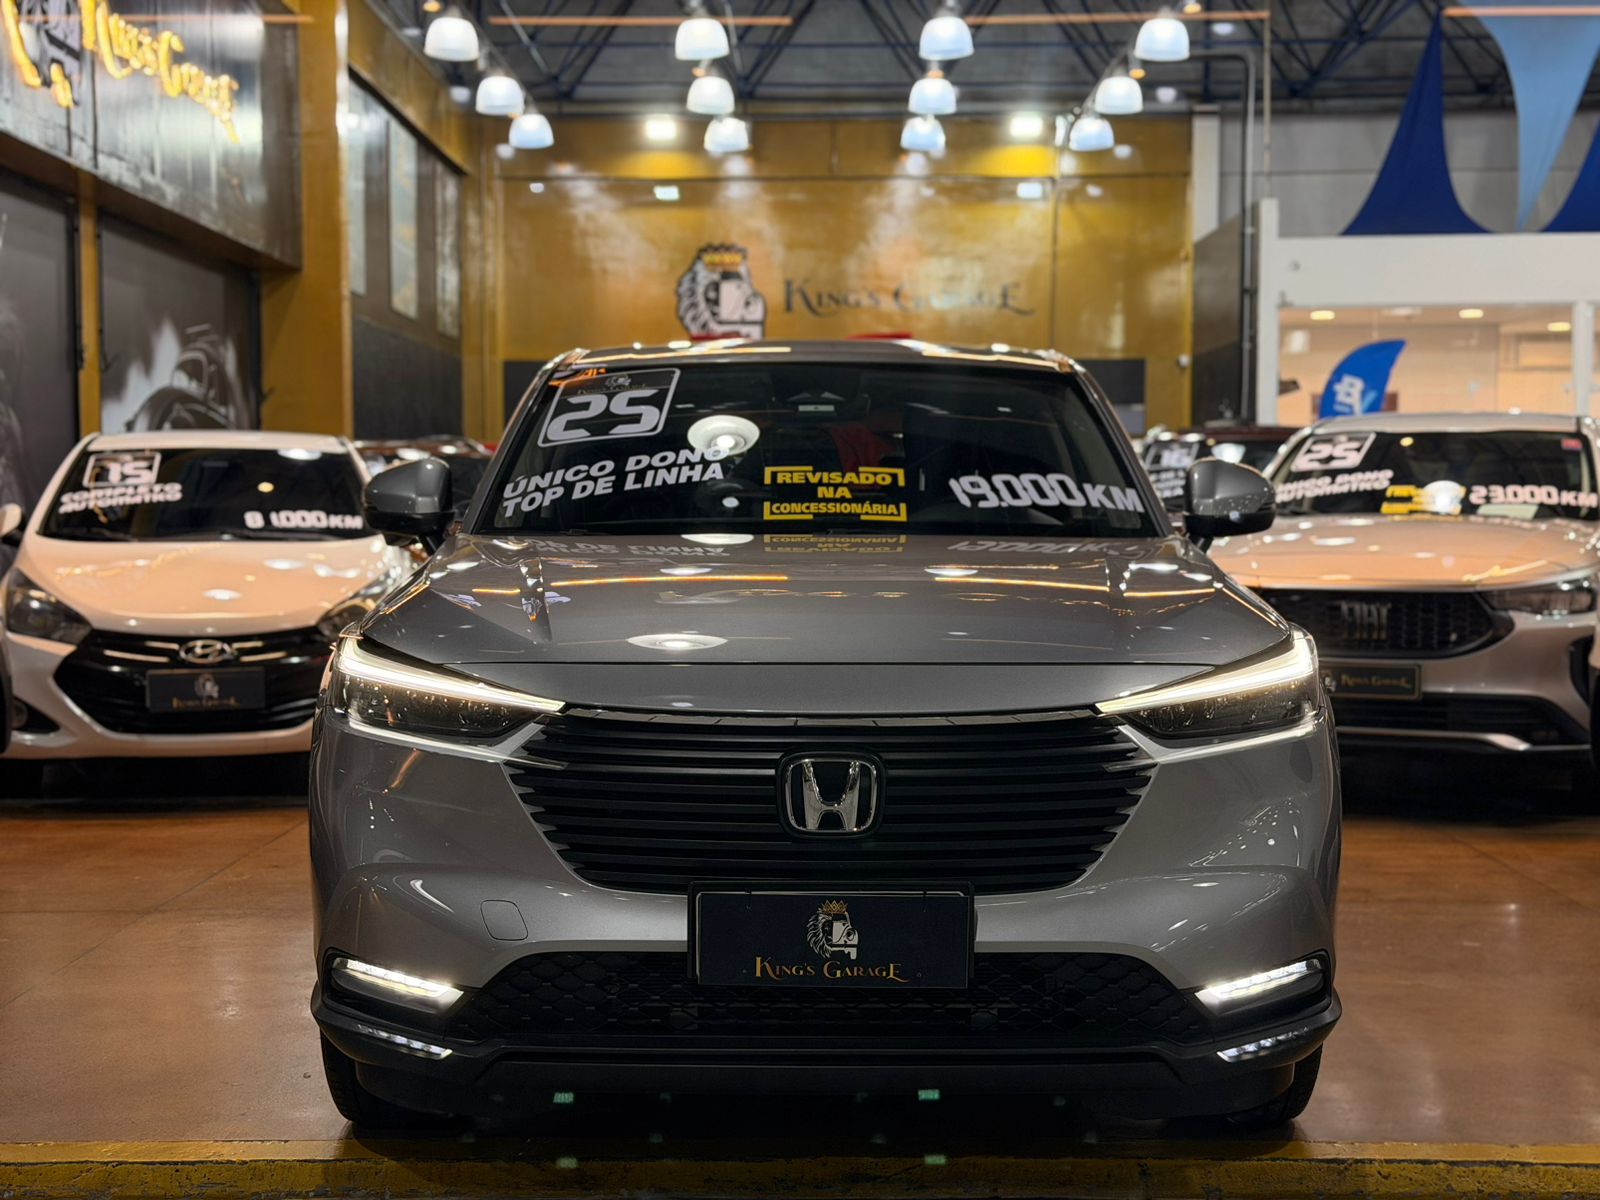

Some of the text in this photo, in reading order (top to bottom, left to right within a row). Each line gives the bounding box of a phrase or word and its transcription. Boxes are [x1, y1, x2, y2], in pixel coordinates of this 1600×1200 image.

[547, 389, 660, 440] 25
[1302, 441, 1361, 467] 25
[503, 446, 730, 498] ÚNICO DONO
[777, 472, 892, 485] REVISADO
[503, 462, 724, 518] TOP DE LINHA
[817, 486, 852, 498] NA
[771, 501, 898, 514] CONCESSIONÁRIA
[755, 956, 910, 983] KING'S GARAGE
